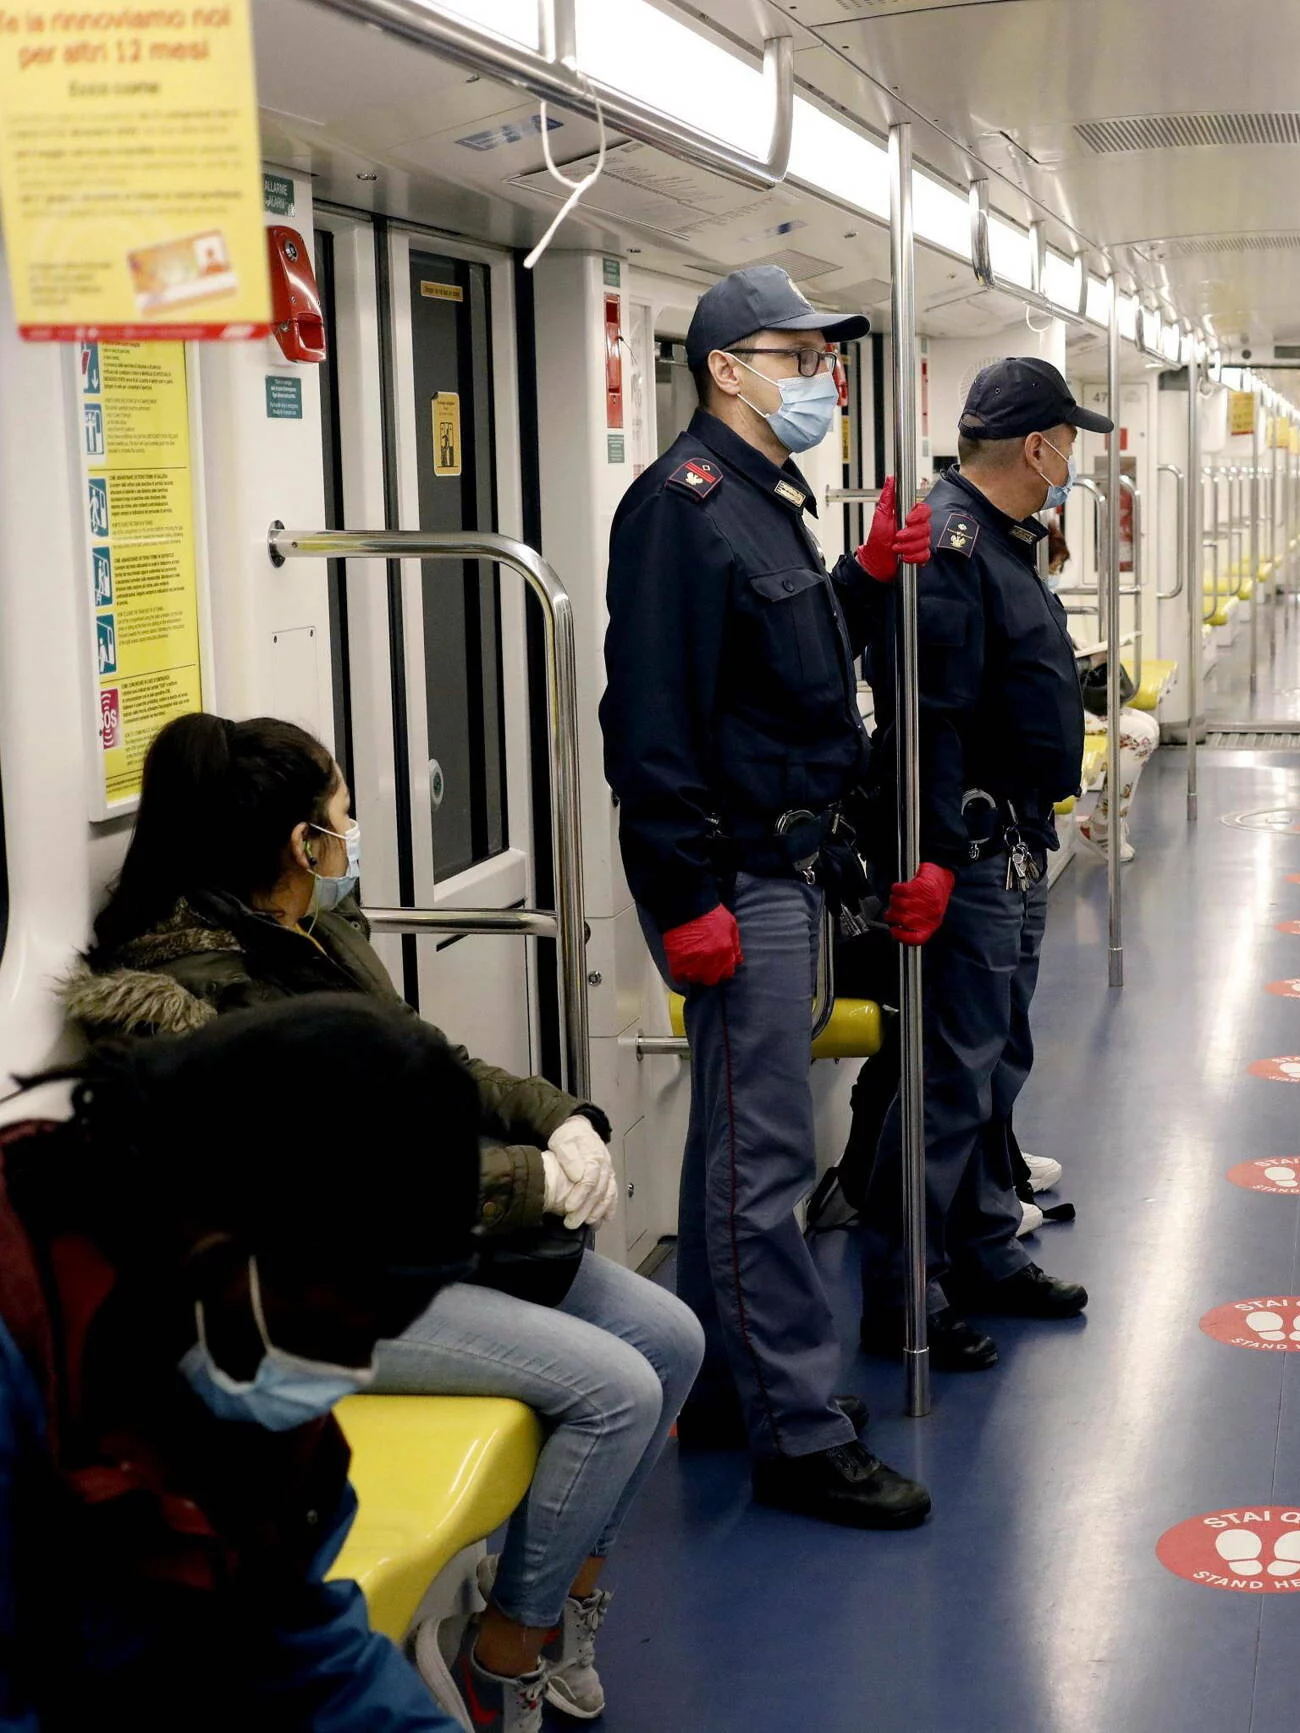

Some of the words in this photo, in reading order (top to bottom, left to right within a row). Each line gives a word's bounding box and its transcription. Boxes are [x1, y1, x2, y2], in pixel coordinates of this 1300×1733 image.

[19, 45, 56, 69] per
[116, 40, 142, 63] 12
[150, 41, 209, 61] mesi
[1253, 1158, 1300, 1167] STAI
[1251, 1184, 1300, 1193] STAND
[1234, 1299, 1288, 1312] STAI
[1231, 1337, 1288, 1350] STAND
[1204, 1511, 1271, 1528] STAI
[1193, 1571, 1264, 1589] STAND
